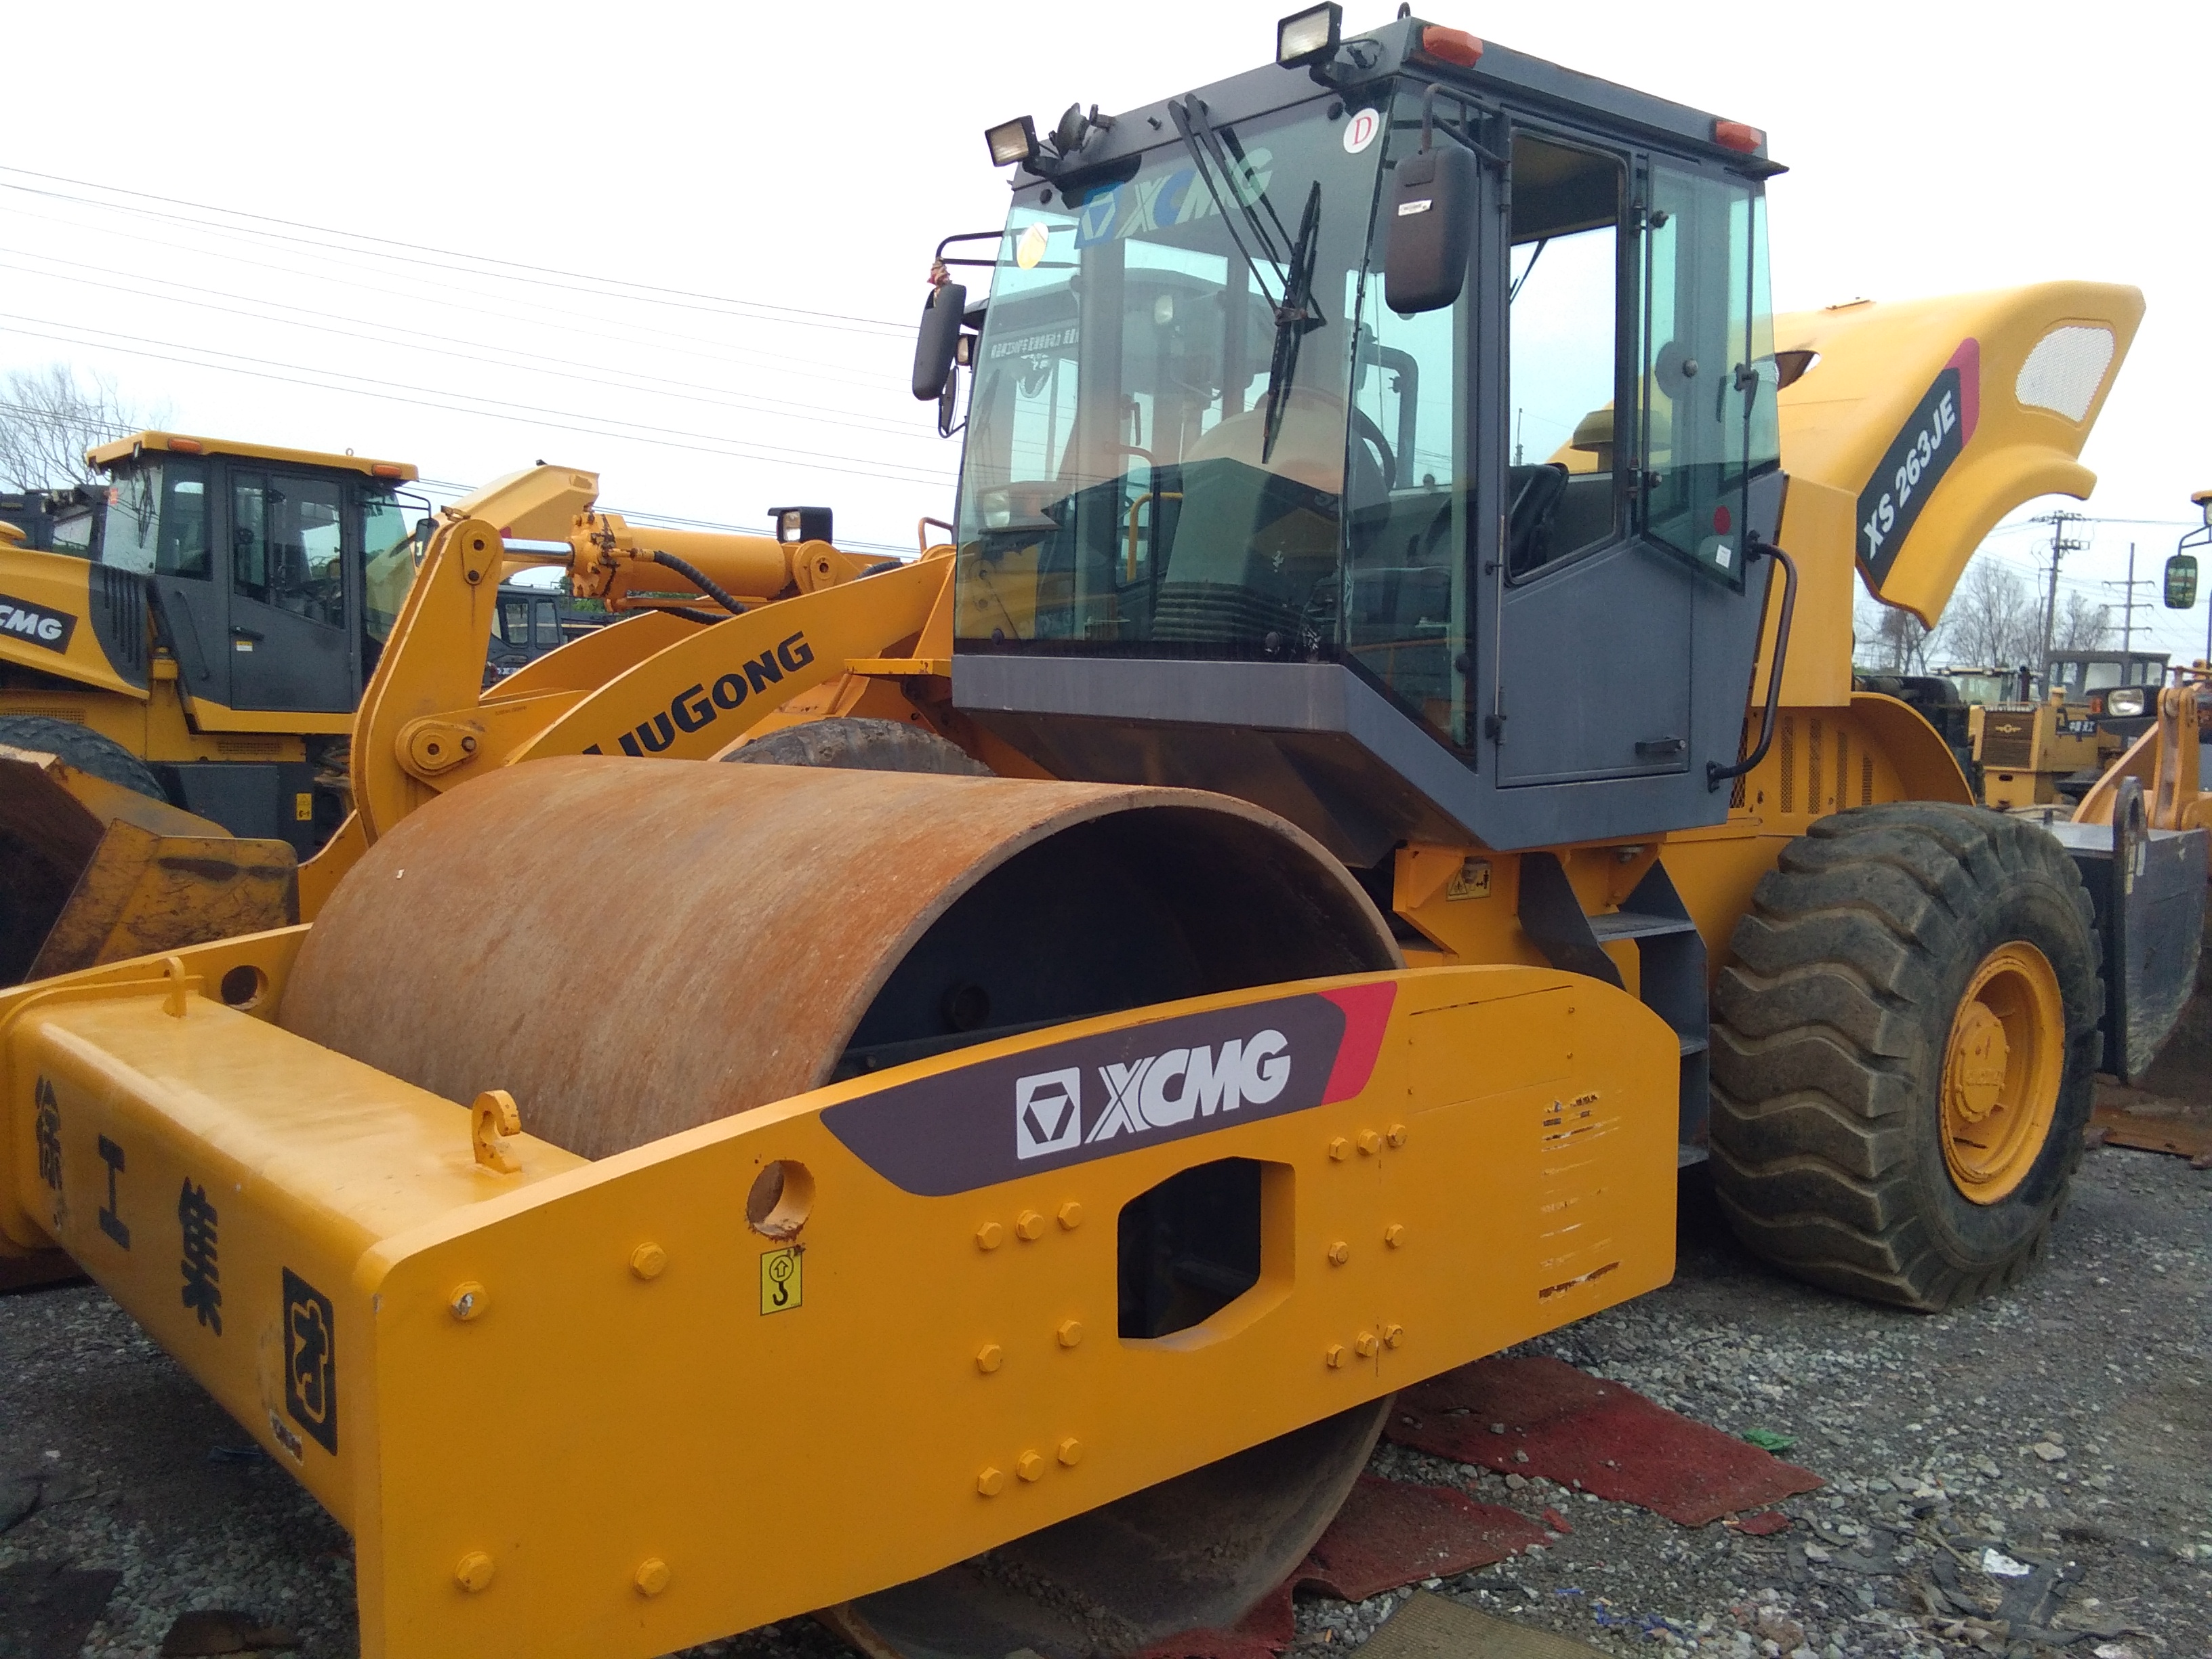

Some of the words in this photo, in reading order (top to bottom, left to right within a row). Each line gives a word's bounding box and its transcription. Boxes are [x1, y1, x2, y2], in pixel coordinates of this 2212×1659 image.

[1353, 116, 1372, 146] D
[1114, 147, 1273, 239] XCMG
[1863, 493, 1895, 560] XS
[1895, 389, 1957, 509] 263JE
[581, 630, 815, 758] IUGONG
[1084, 1029, 1292, 1144] XCMG
